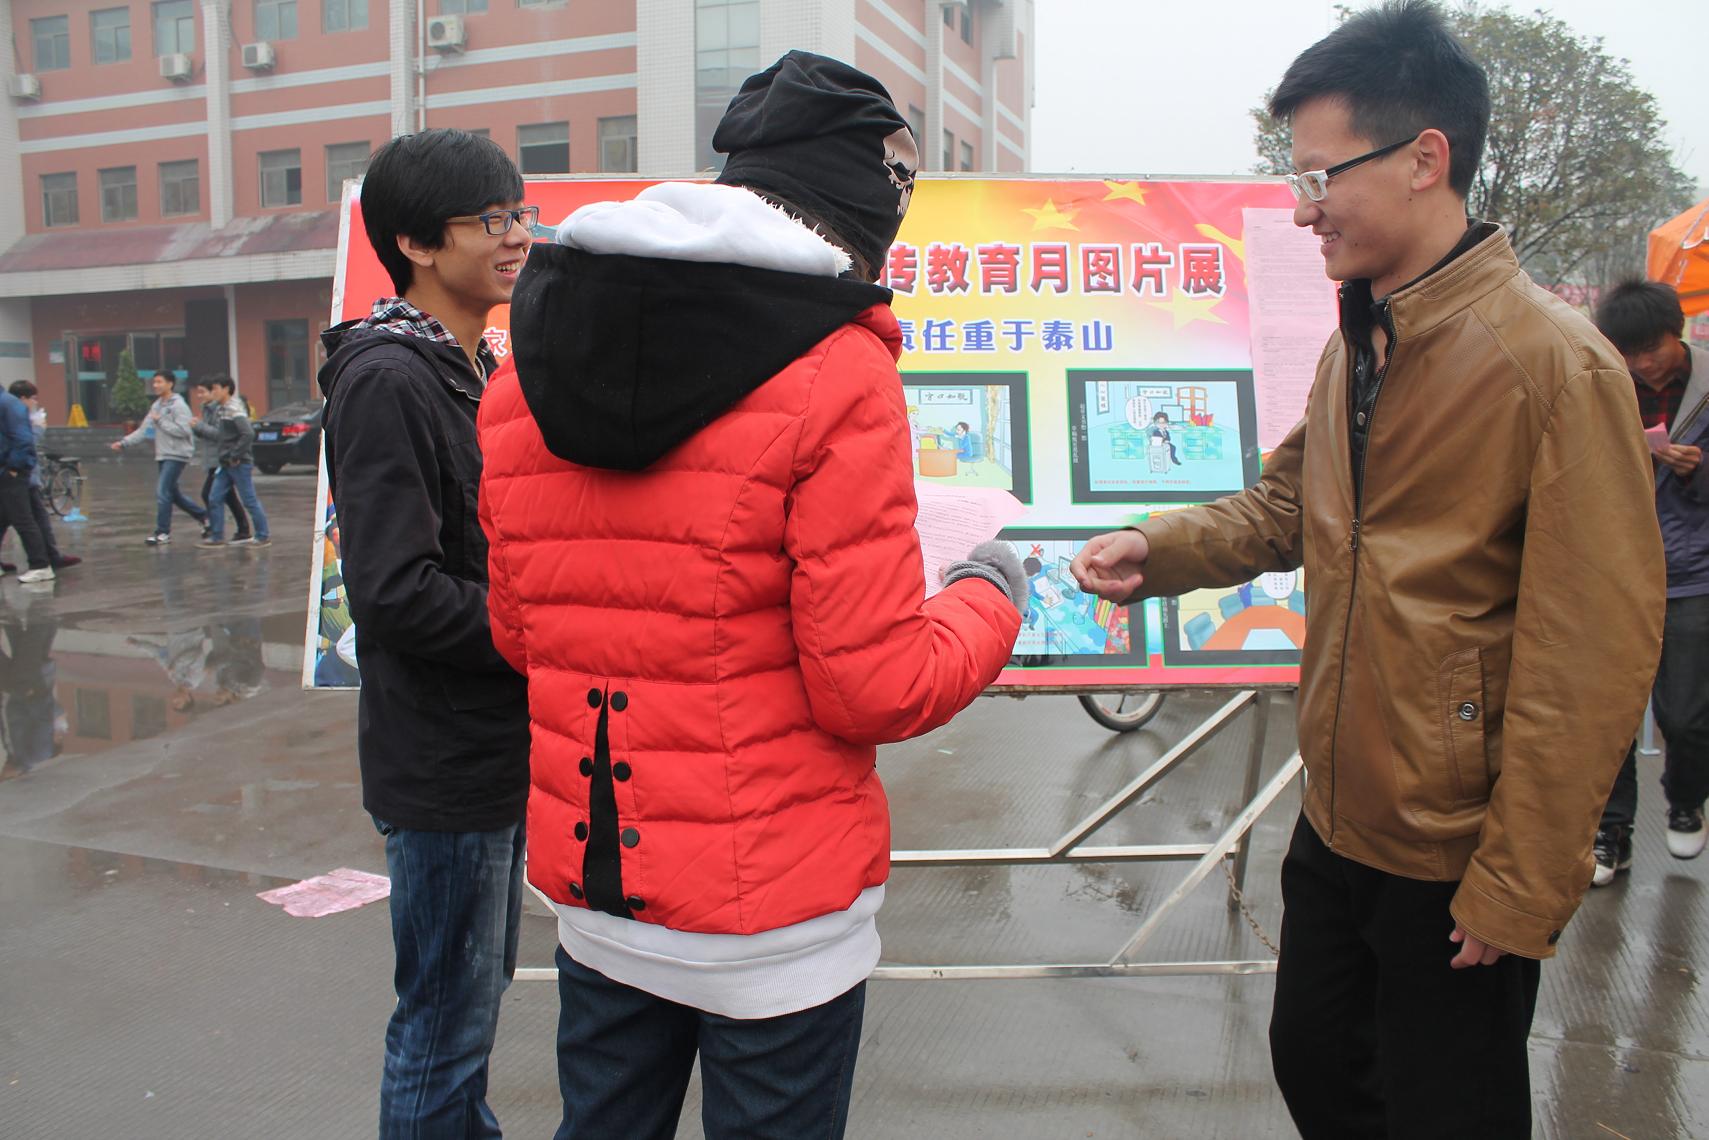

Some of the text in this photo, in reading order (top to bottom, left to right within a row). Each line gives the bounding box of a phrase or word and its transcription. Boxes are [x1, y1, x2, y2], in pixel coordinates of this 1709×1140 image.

[881, 244, 1226, 294] 传教育月图片展
